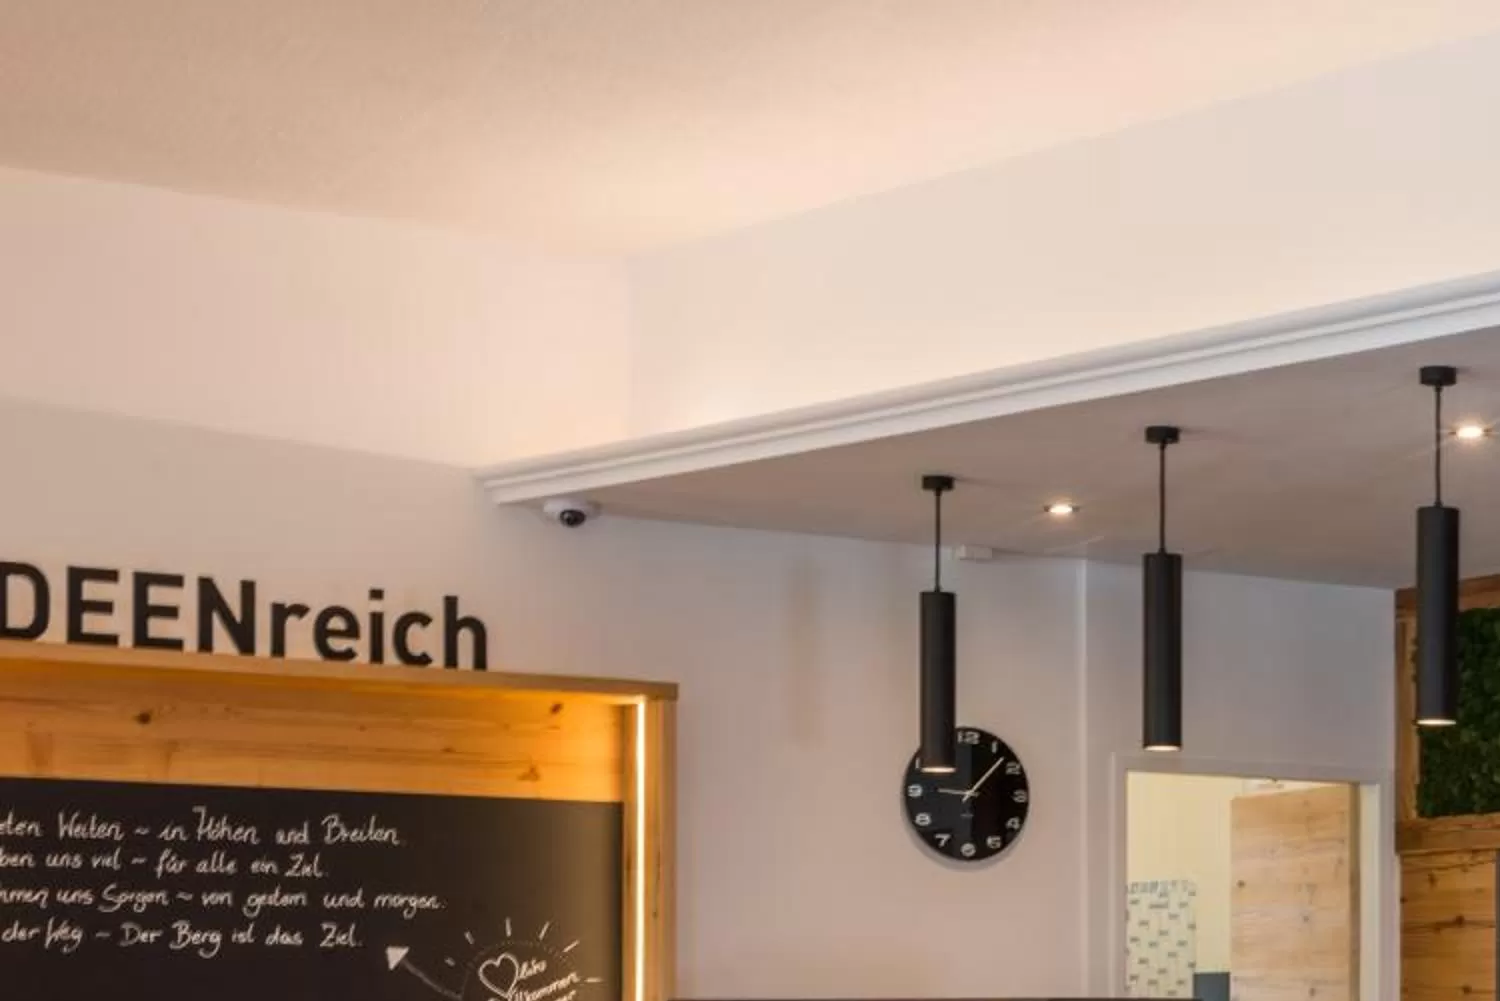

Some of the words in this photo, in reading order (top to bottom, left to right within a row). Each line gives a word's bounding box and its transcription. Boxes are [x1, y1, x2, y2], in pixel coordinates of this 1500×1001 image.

[0, 561, 488, 671] DEENreich
[957, 731, 981, 745] 12
[1005, 761, 1021, 775] 2
[907, 784, 923, 797] 9
[58, 810, 125, 841] Weiten
[157, 823, 188, 841] in
[192, 805, 261, 845] Höhen
[276, 820, 310, 845] und
[915, 813, 931, 826] 8
[1005, 817, 1021, 830] 4
[934, 833, 951, 848] 7
[986, 835, 1002, 849] 5
[45, 853, 82, 869] uns
[91, 846, 122, 871] viel
[155, 848, 188, 880] für
[195, 850, 238, 874] alle
[250, 856, 279, 875] ein
[56, 888, 94, 905] uns
[98, 883, 169, 913] Sorgen
[201, 891, 233, 907] von
[242, 883, 308, 919] gestern
[323, 887, 365, 909] und
[1, 920, 41, 943] der
[44, 917, 84, 954] Weg
[118, 921, 163, 947] Der
[169, 920, 223, 958] Berg
[231, 923, 256, 944] ist
[264, 924, 304, 945] das
